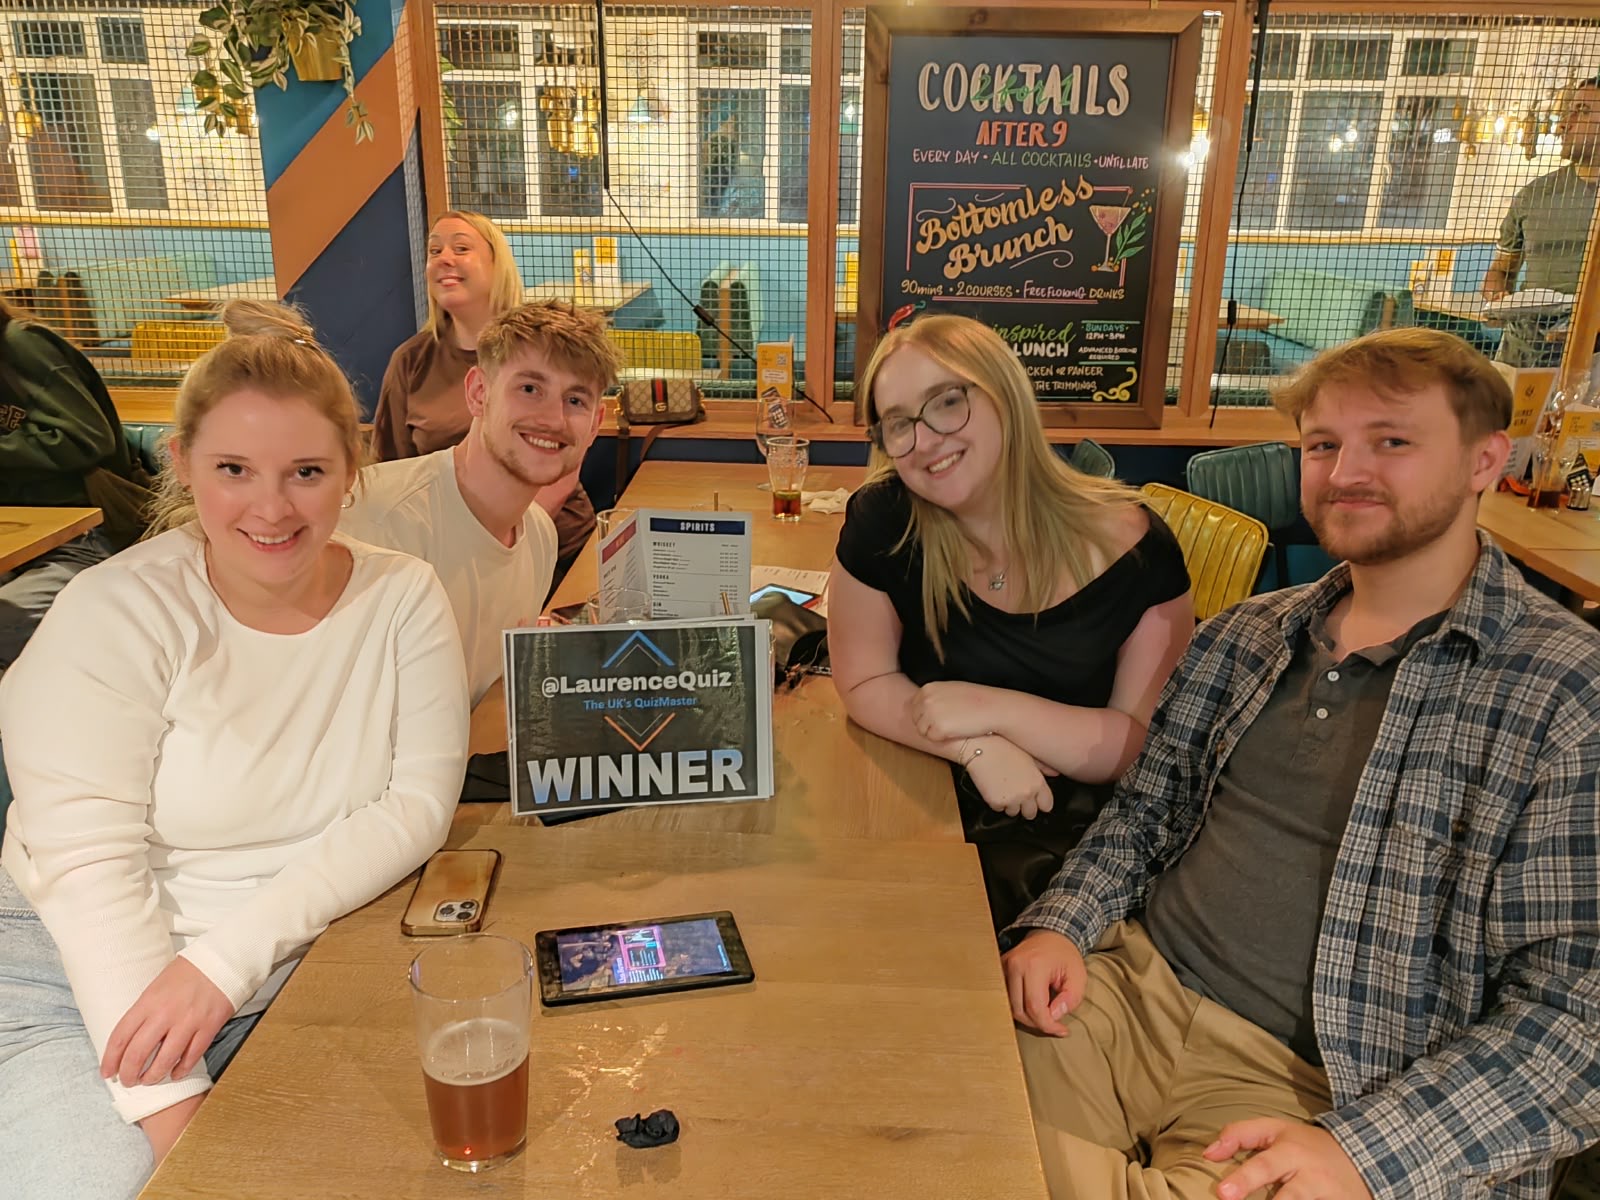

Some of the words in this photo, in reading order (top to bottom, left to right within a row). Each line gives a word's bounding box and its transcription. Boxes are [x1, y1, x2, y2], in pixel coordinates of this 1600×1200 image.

[918, 62, 1130, 116] COCKTAILS
[976, 120, 1048, 147] AFTER
[1051, 120, 1069, 147] 9
[912, 149, 951, 163] EVERY
[954, 151, 980, 165] DAY
[990, 152, 1018, 166] ALL
[1021, 152, 1092, 168] COCKTAILS
[1098, 154, 1125, 170] UNTIL
[1126, 156, 1149, 170] LATE
[915, 174, 1094, 254] Bottomless
[943, 216, 1073, 280] Brunch
[901, 280, 943, 296] 90mins
[965, 285, 1013, 298] COURSES
[1089, 287, 1125, 300] DRINKS
[1085, 323, 1126, 333] SUNDAYS
[1013, 341, 1069, 358] LUNCH
[1067, 366, 1104, 377] PANEER
[1034, 380, 1051, 391] THE
[1052, 380, 1098, 392] TRIMMINGS
[680, 521, 716, 533] SPIRITS
[541, 669, 732, 698] @LaurenceQuiz
[583, 700, 605, 711] The
[607, 698, 632, 710] UK's
[634, 697, 698, 709] QuizMaster
[527, 749, 746, 804] WINNER
